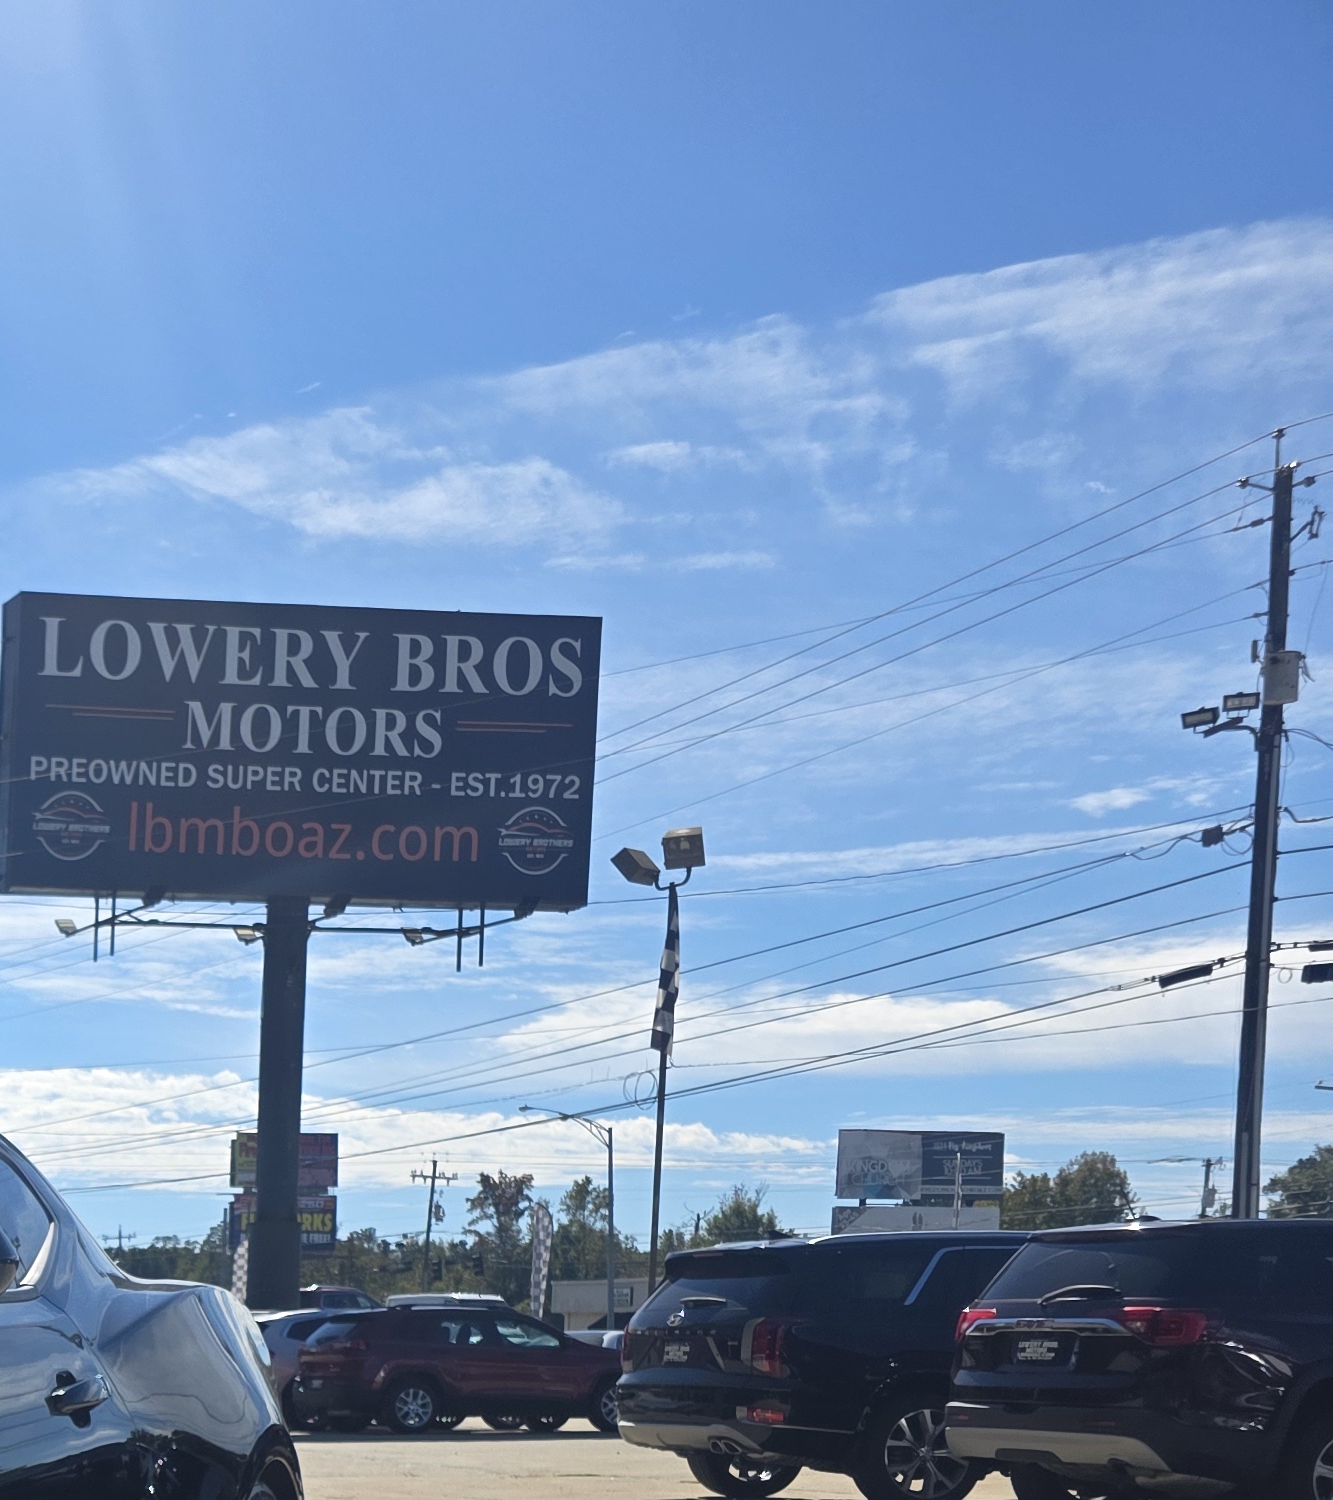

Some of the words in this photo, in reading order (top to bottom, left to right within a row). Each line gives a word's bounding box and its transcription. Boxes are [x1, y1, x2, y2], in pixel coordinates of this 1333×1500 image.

[37, 616, 370, 690] LOWERY
[390, 632, 583, 698] BROS
[182, 701, 442, 759] MOTORS
[30, 756, 197, 787] PREOWNED
[206, 764, 302, 792] SUPER
[312, 768, 423, 796] CENTER
[450, 771, 581, 799] EST.1972
[128, 801, 479, 862] lbmboaz.com
